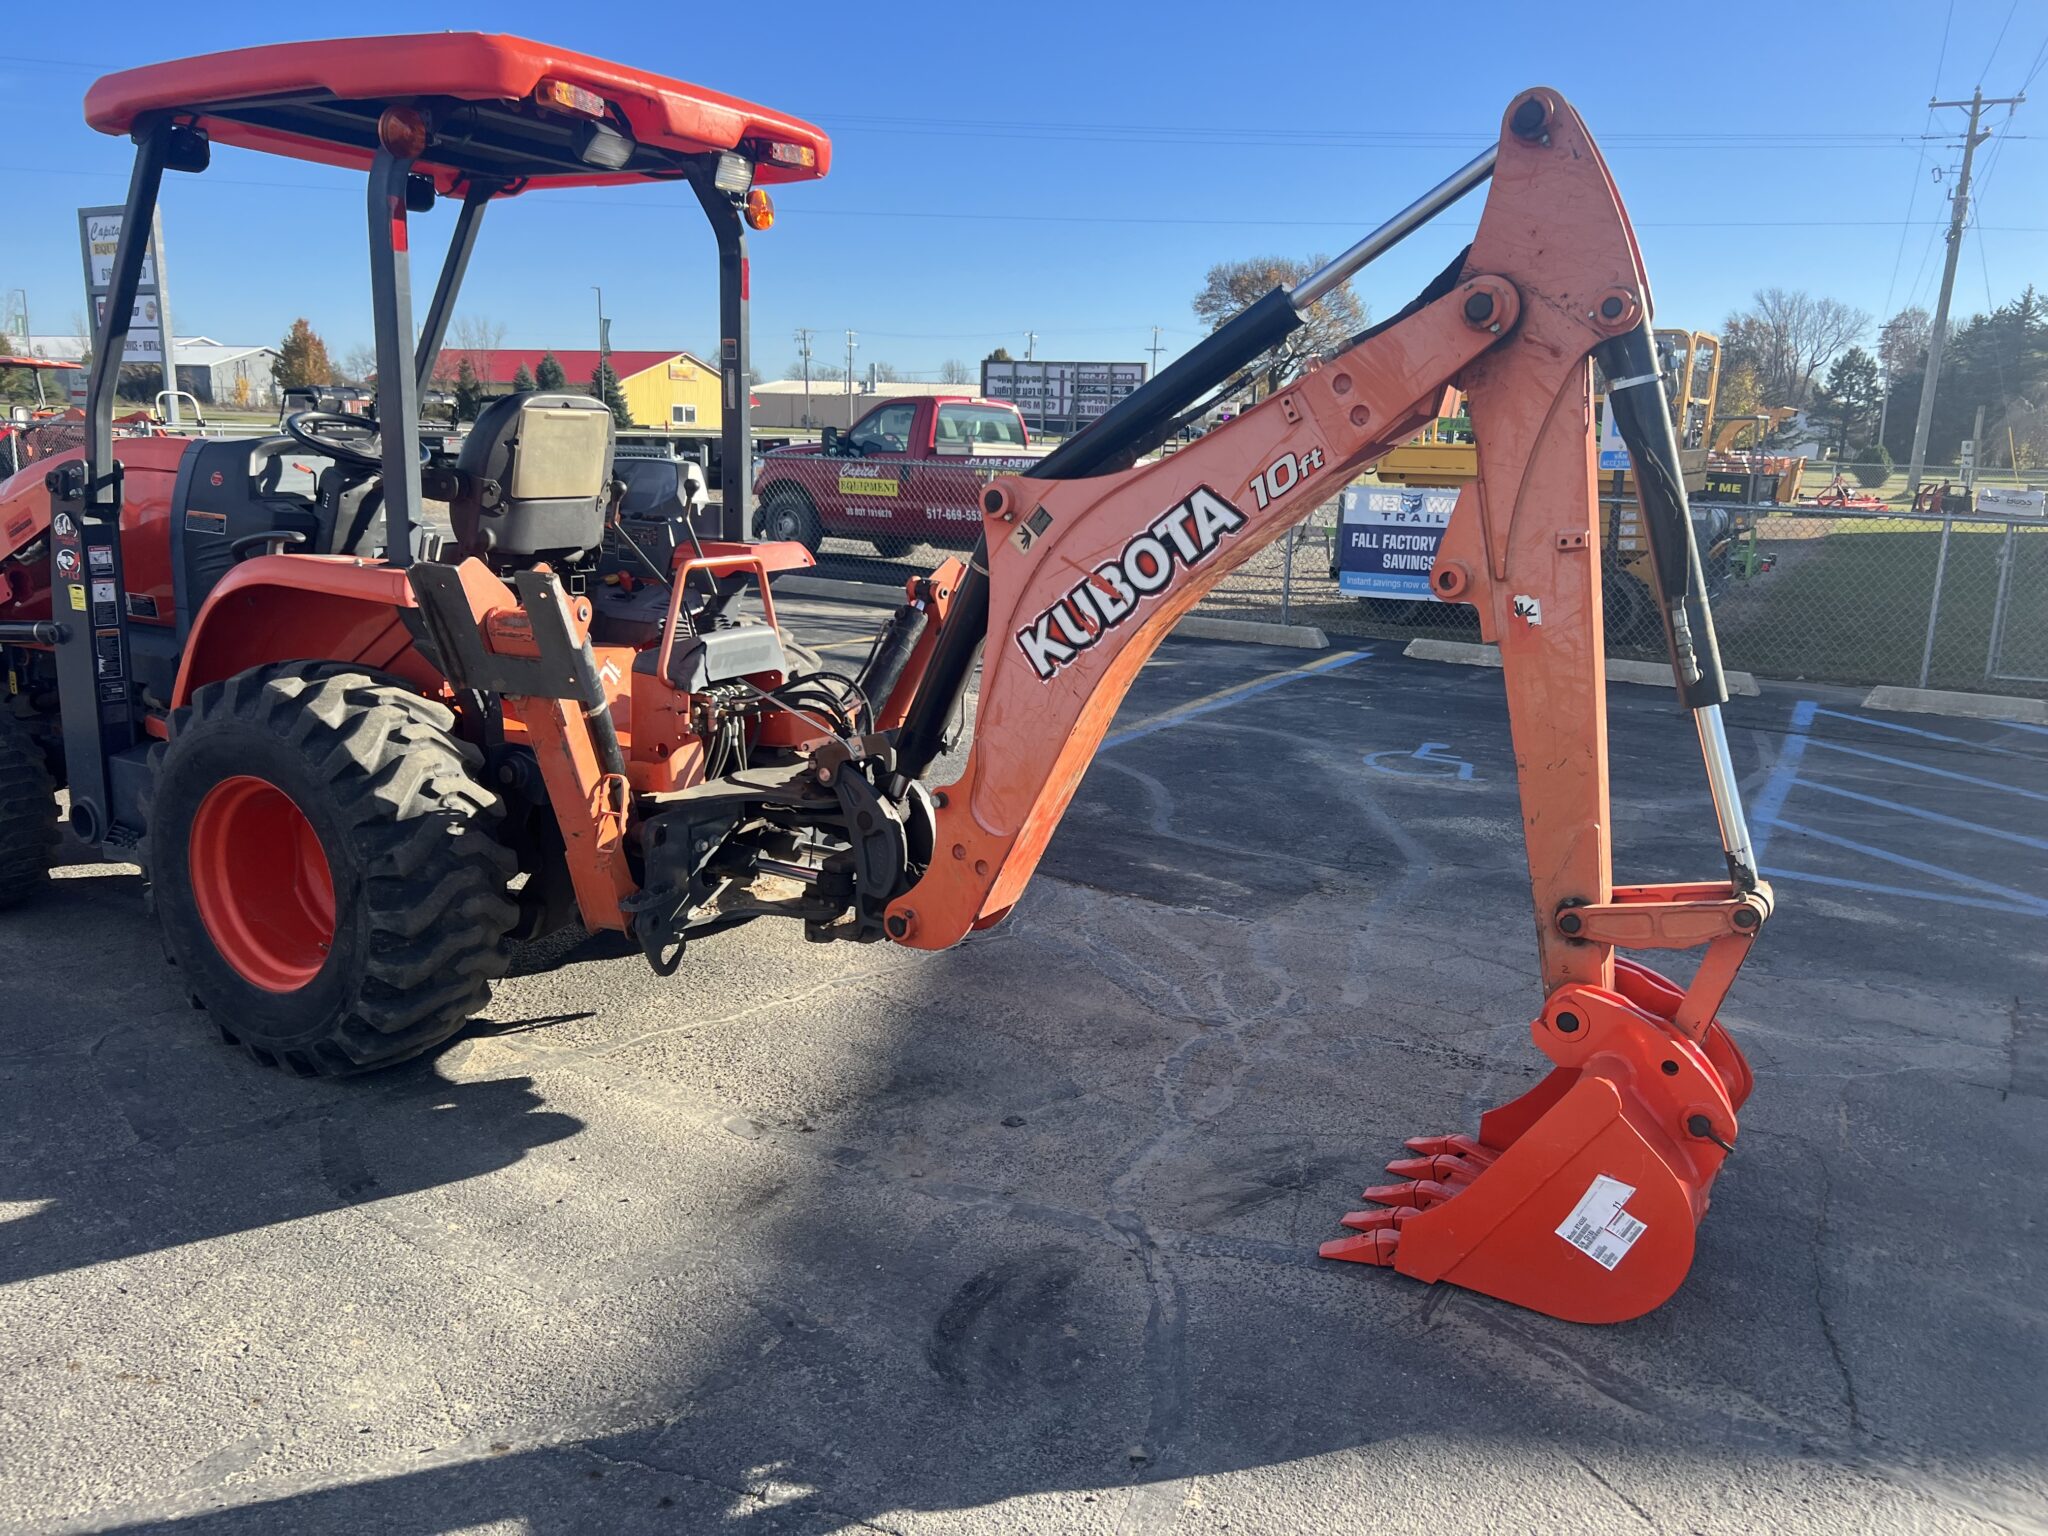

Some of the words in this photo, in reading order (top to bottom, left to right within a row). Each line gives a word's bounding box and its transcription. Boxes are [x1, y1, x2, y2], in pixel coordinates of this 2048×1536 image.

[91, 222, 120, 241] Capita
[1037, 387, 1054, 397] Tun
[839, 462, 880, 478] Capital
[1249, 447, 1325, 510] 10ft
[840, 480, 897, 494] EQUIPMENT
[1719, 484, 1742, 493] ME
[926, 508, 982, 521] 517-669-553
[1381, 512, 1445, 524] TRAIL
[1352, 532, 1379, 549] FALL
[1382, 534, 1437, 551] FACTORY
[1382, 553, 1436, 571] SAVINGS
[1017, 486, 1247, 680] KUBOTA
[1346, 576, 1372, 586] Instant
[1373, 578, 1401, 590] savings
[1402, 581, 1420, 589] now
